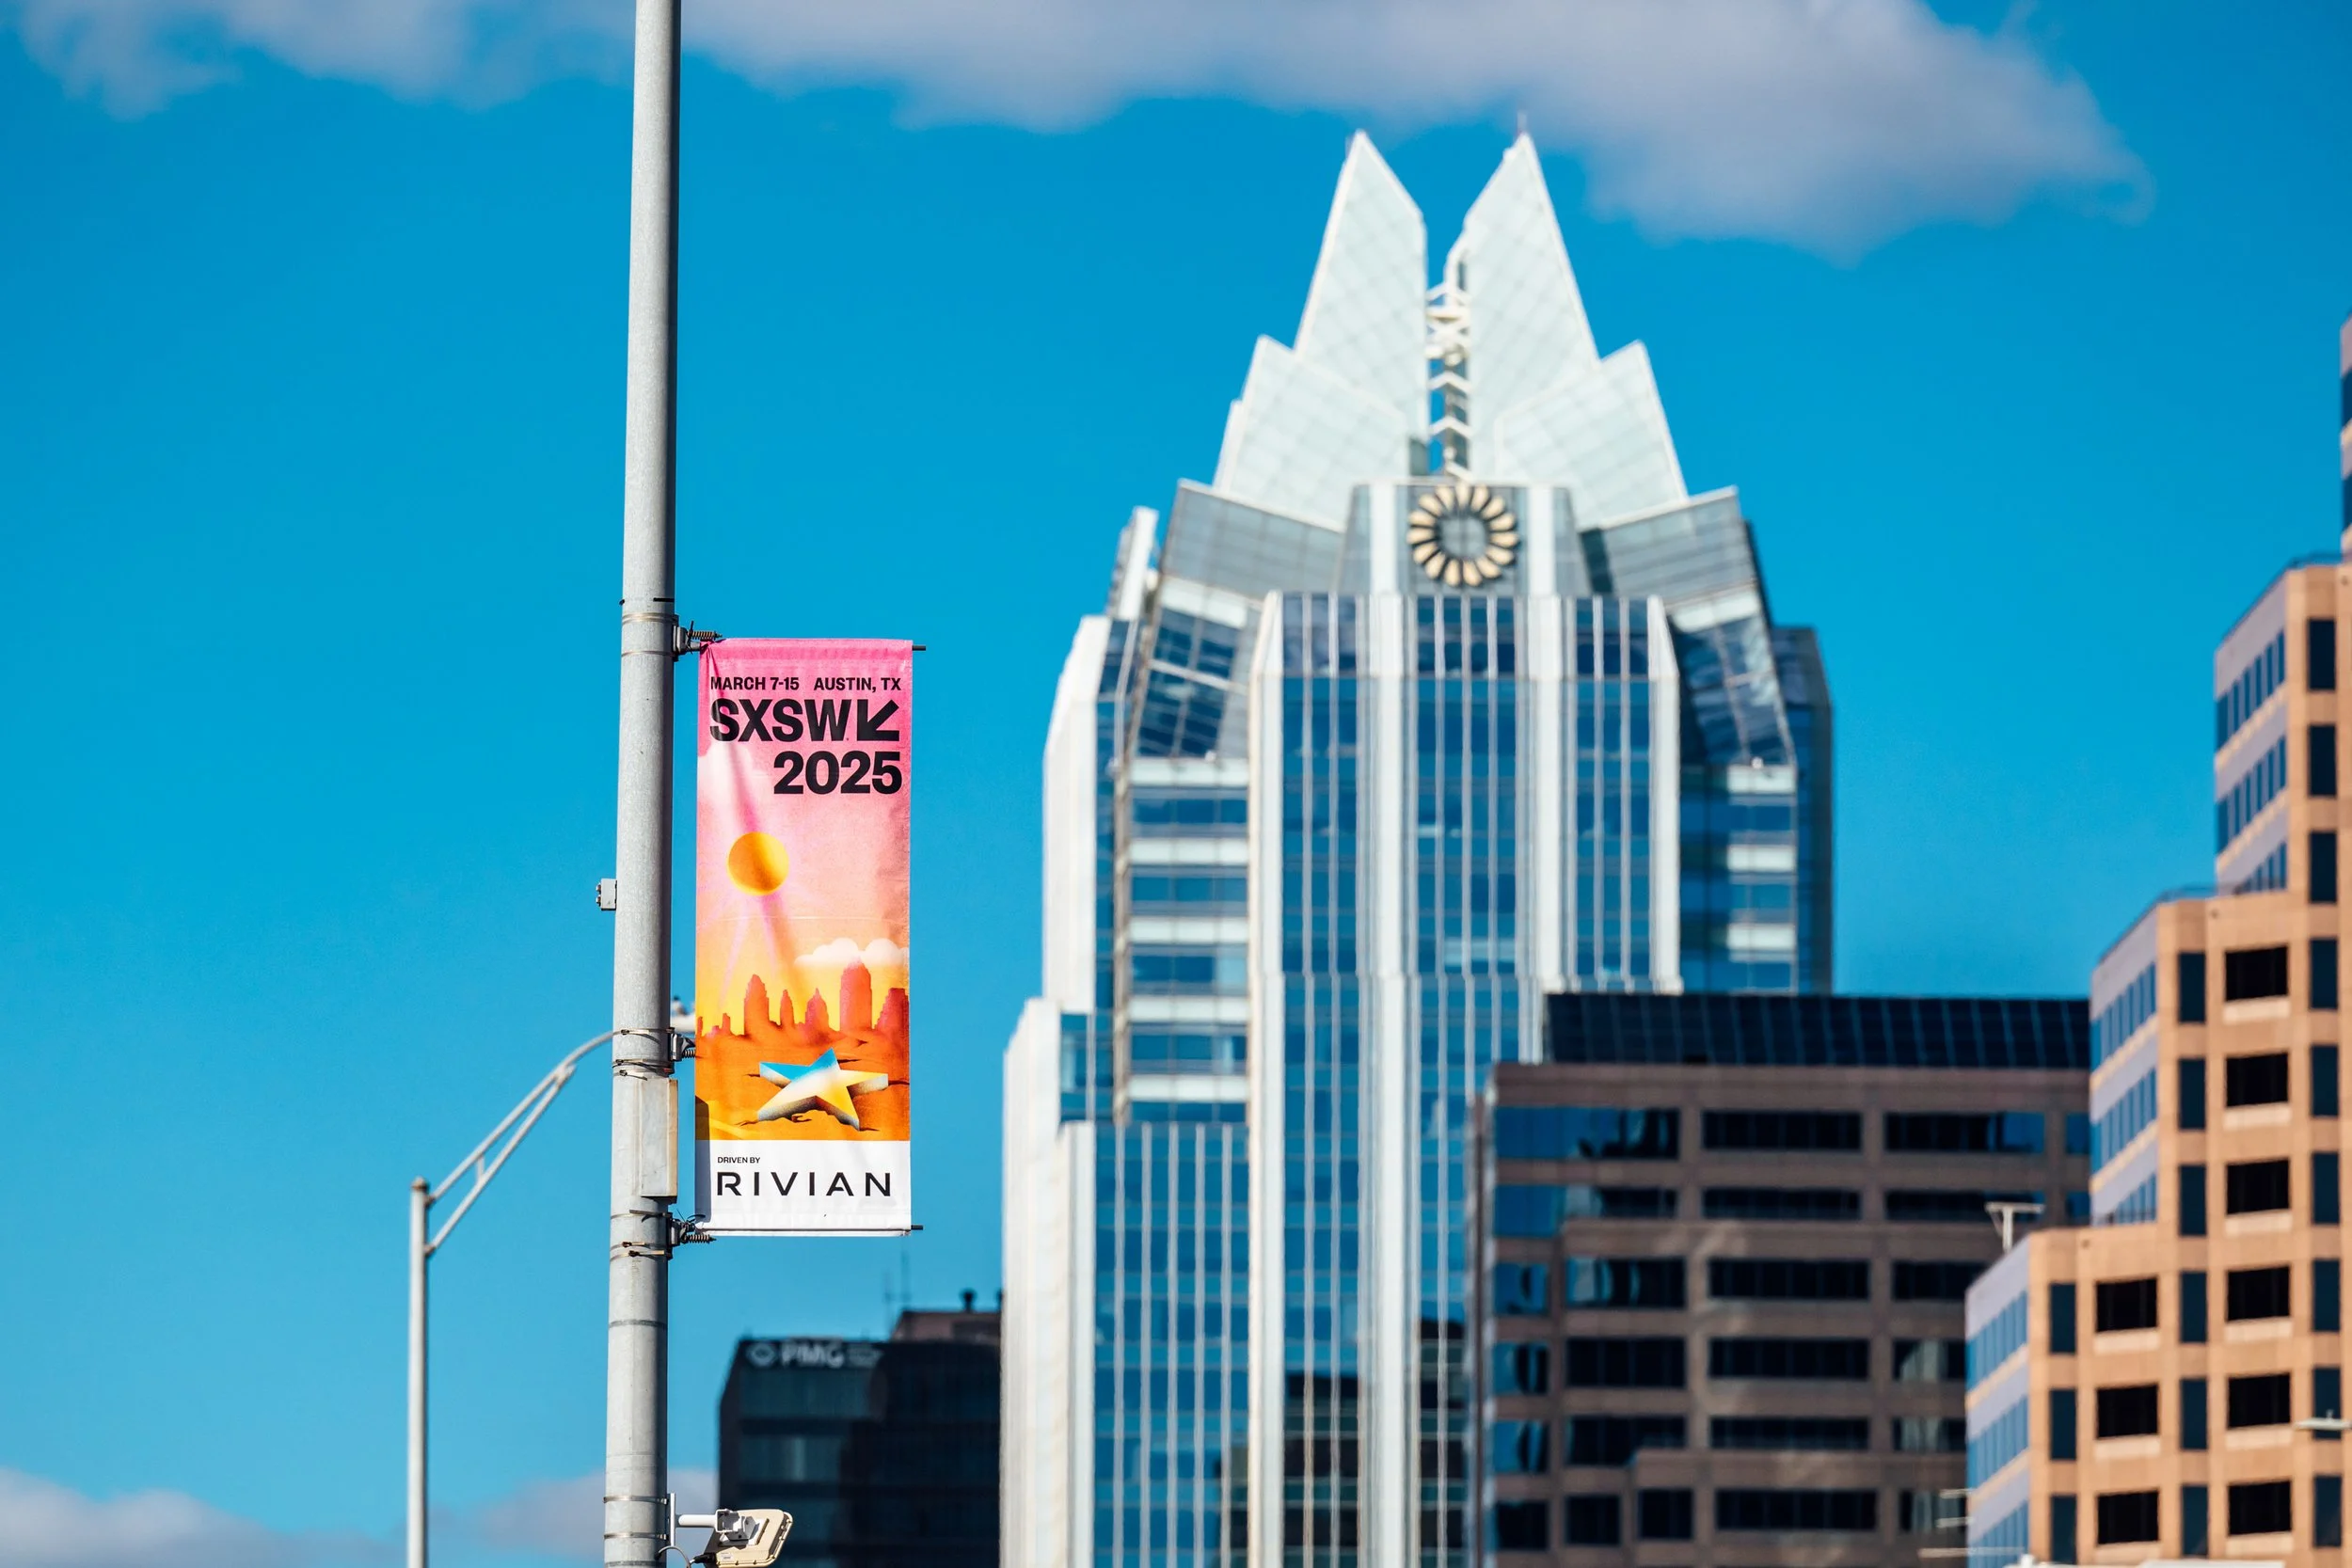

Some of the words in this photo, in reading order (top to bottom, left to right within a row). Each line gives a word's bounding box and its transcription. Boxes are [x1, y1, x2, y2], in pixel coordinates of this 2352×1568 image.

[710, 676, 766, 690] MARCH
[770, 676, 800, 690] 7-15
[814, 677, 876, 693] AUSTIN,
[881, 677, 901, 690] TX
[709, 698, 852, 742] SXSW
[773, 750, 902, 795] 2025
[717, 1172, 891, 1197] RIVIAN
